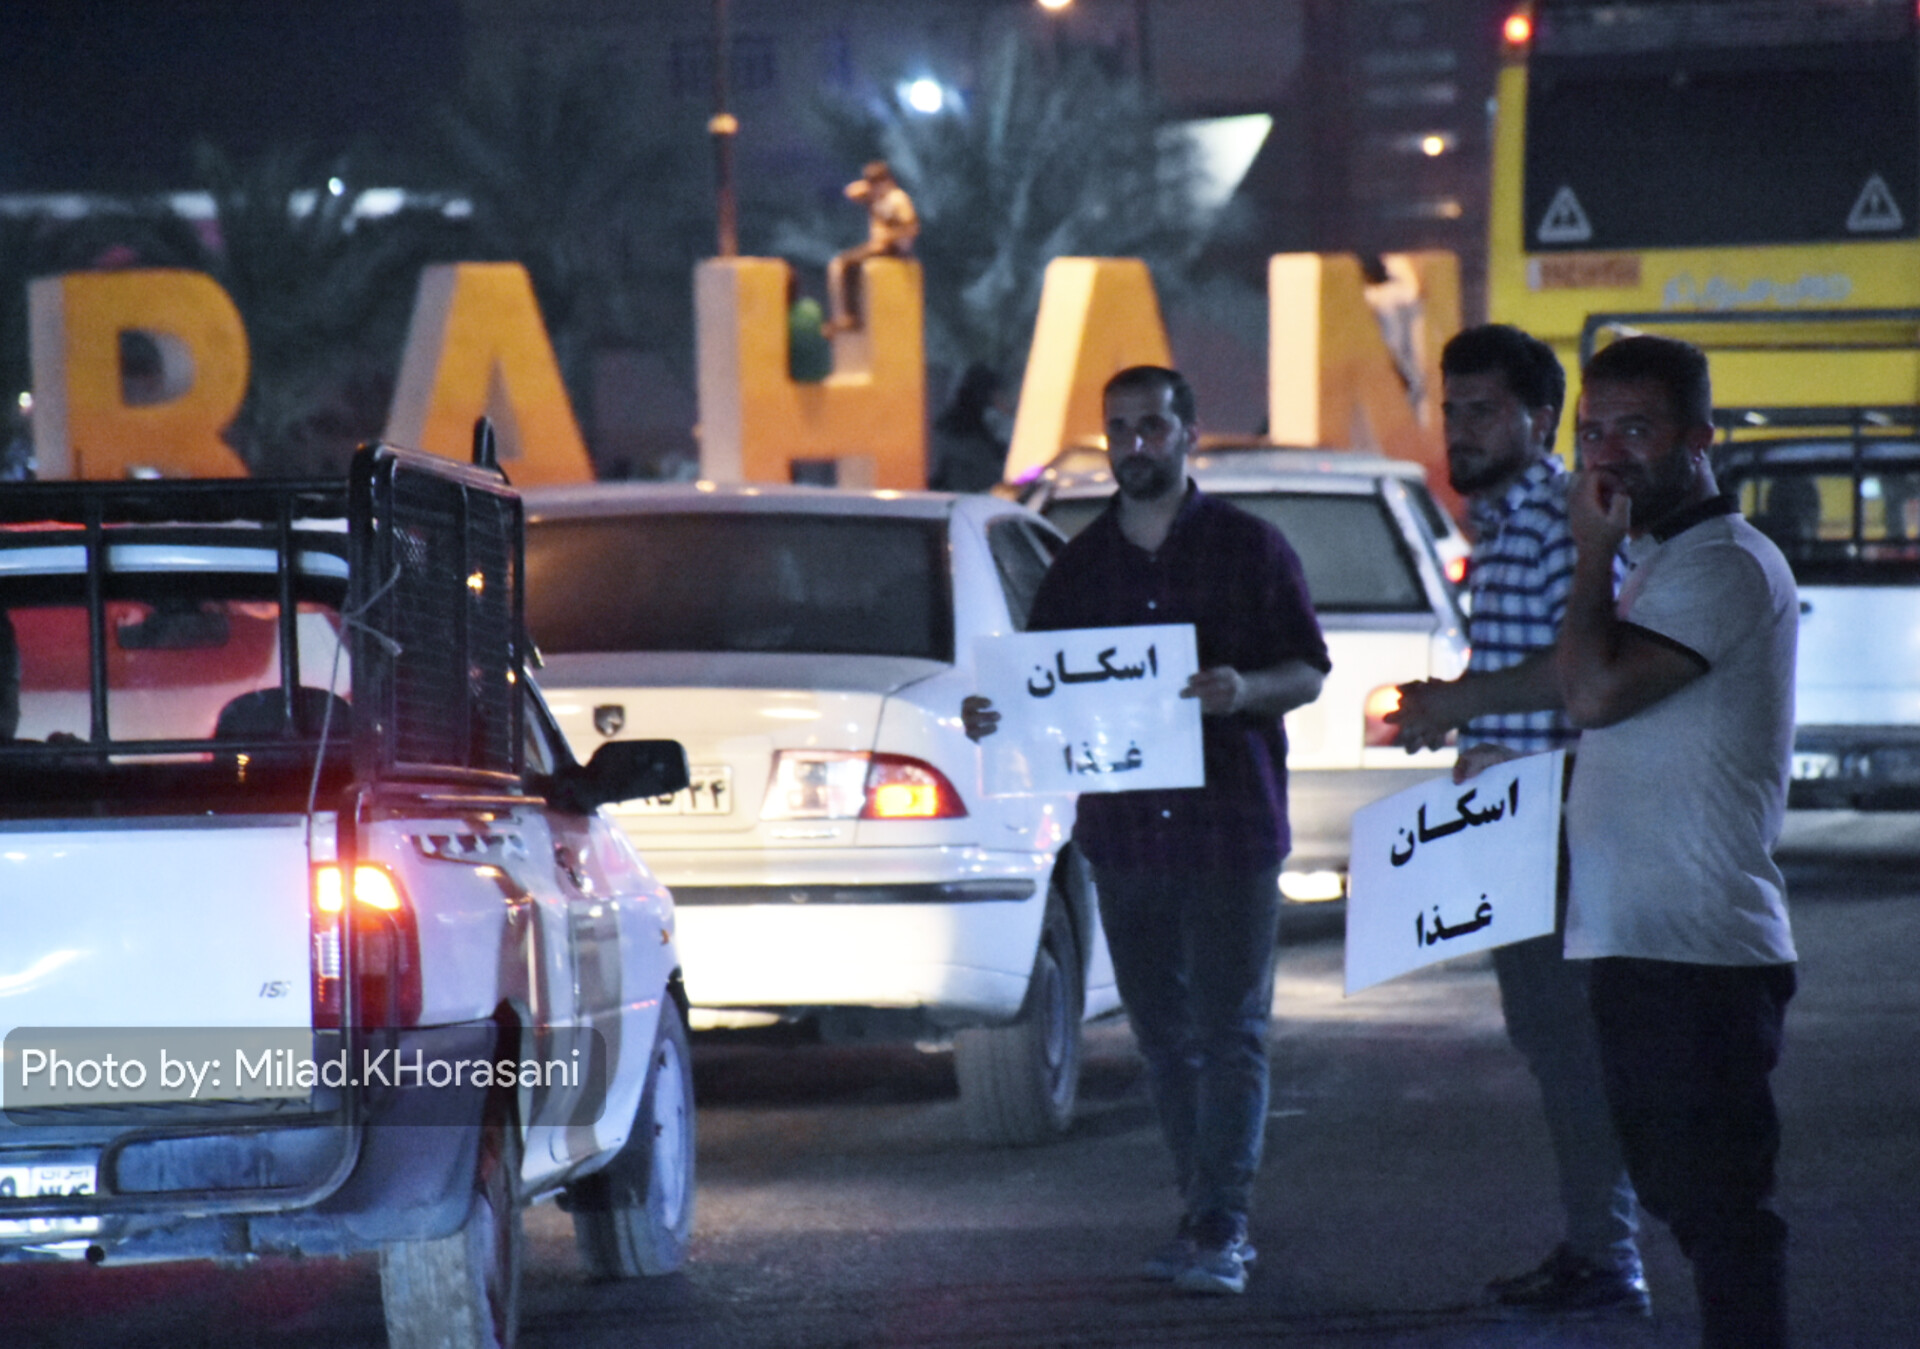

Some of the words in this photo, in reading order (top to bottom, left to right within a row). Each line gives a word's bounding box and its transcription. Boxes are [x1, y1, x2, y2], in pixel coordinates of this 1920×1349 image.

[1028, 644, 1157, 698] اسکان
[1063, 741, 1143, 775] غذا
[1391, 777, 1519, 867] اسکان
[1416, 893, 1493, 948] غذا
